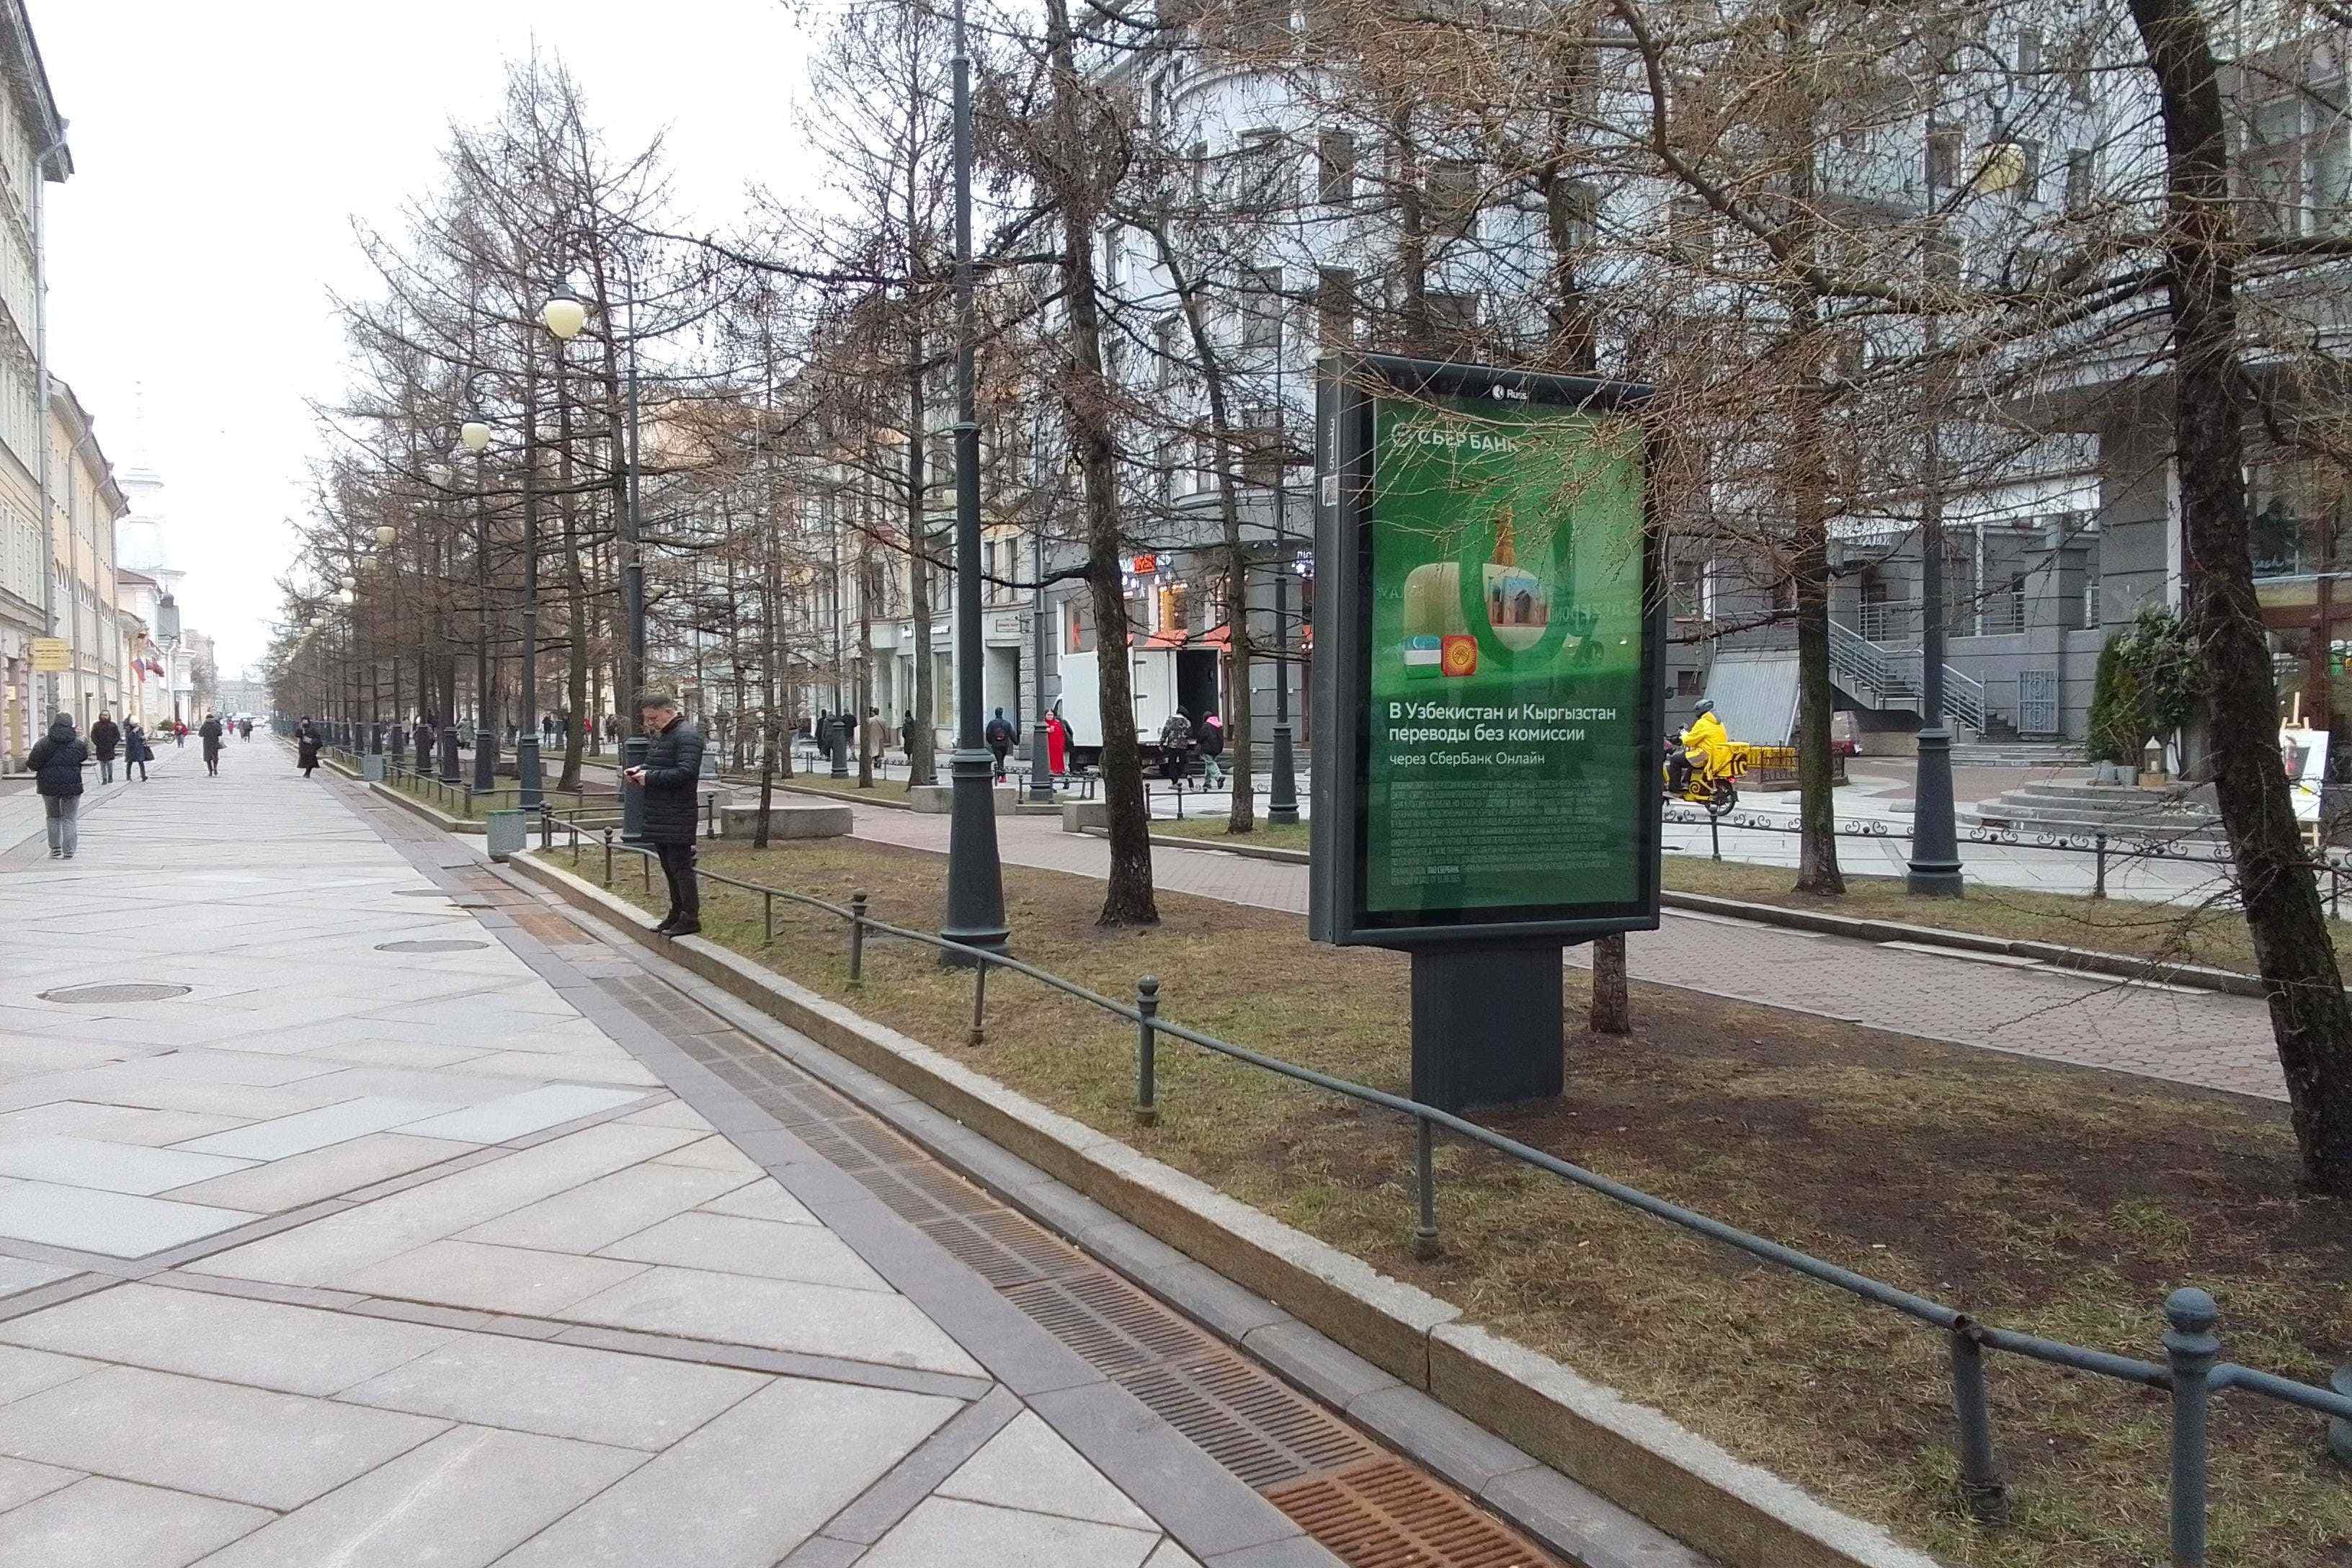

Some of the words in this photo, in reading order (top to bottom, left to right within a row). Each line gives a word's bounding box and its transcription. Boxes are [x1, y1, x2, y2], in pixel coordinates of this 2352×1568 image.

[1507, 388, 1528, 400] Russ
[1389, 703, 1401, 719] В
[1405, 702, 1503, 720] Узбекистан
[1508, 708, 1518, 719] и
[1523, 703, 1616, 723] Кыргызстан
[1389, 728, 1470, 744] переводы
[1474, 723, 1505, 741] без
[1508, 728, 1585, 741] комиссии
[1389, 754, 1425, 767] через
[1430, 752, 1492, 767] СберБанк
[1496, 751, 1545, 765] Онлайн
